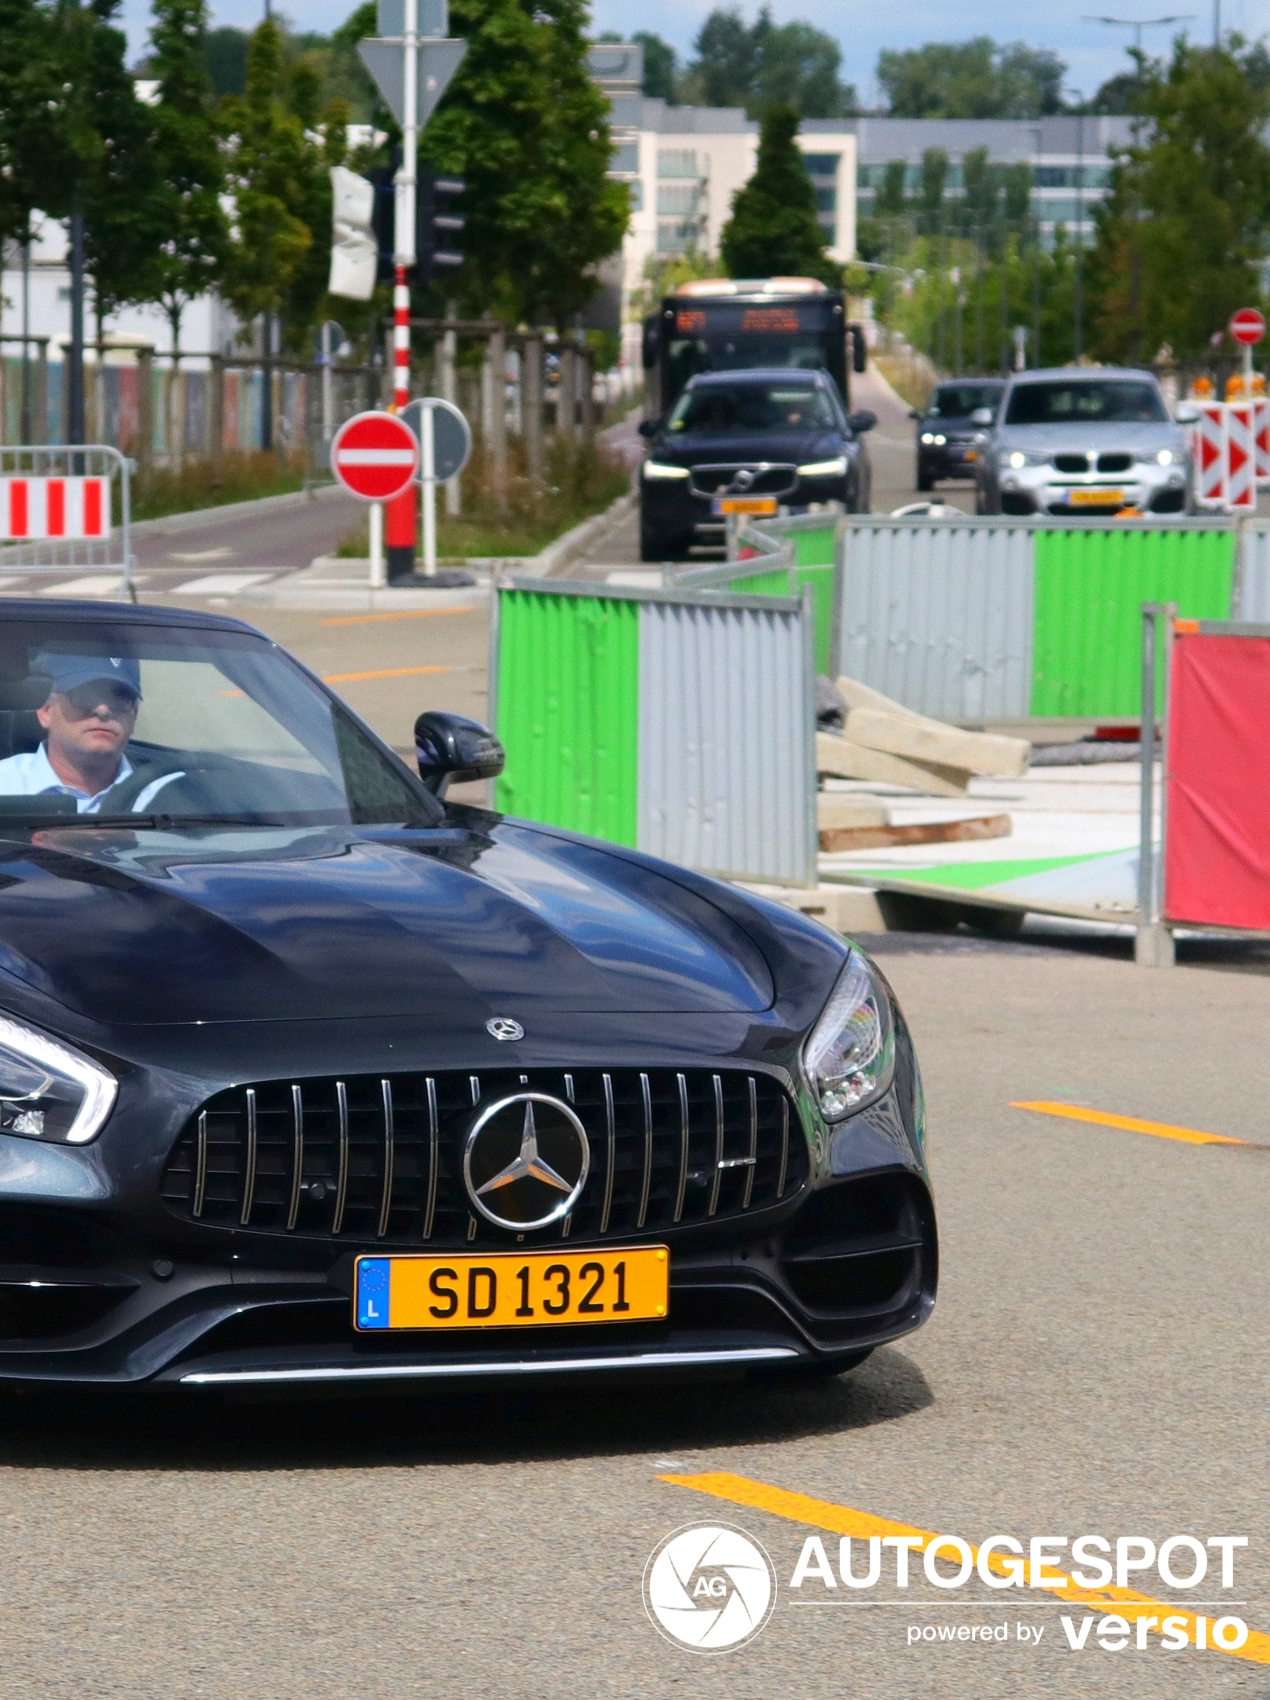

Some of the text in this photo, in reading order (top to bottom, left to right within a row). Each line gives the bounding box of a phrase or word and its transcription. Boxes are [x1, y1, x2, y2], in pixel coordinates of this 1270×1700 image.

[367, 1299, 380, 1318] L
[428, 1261, 630, 1319] SD 1321
